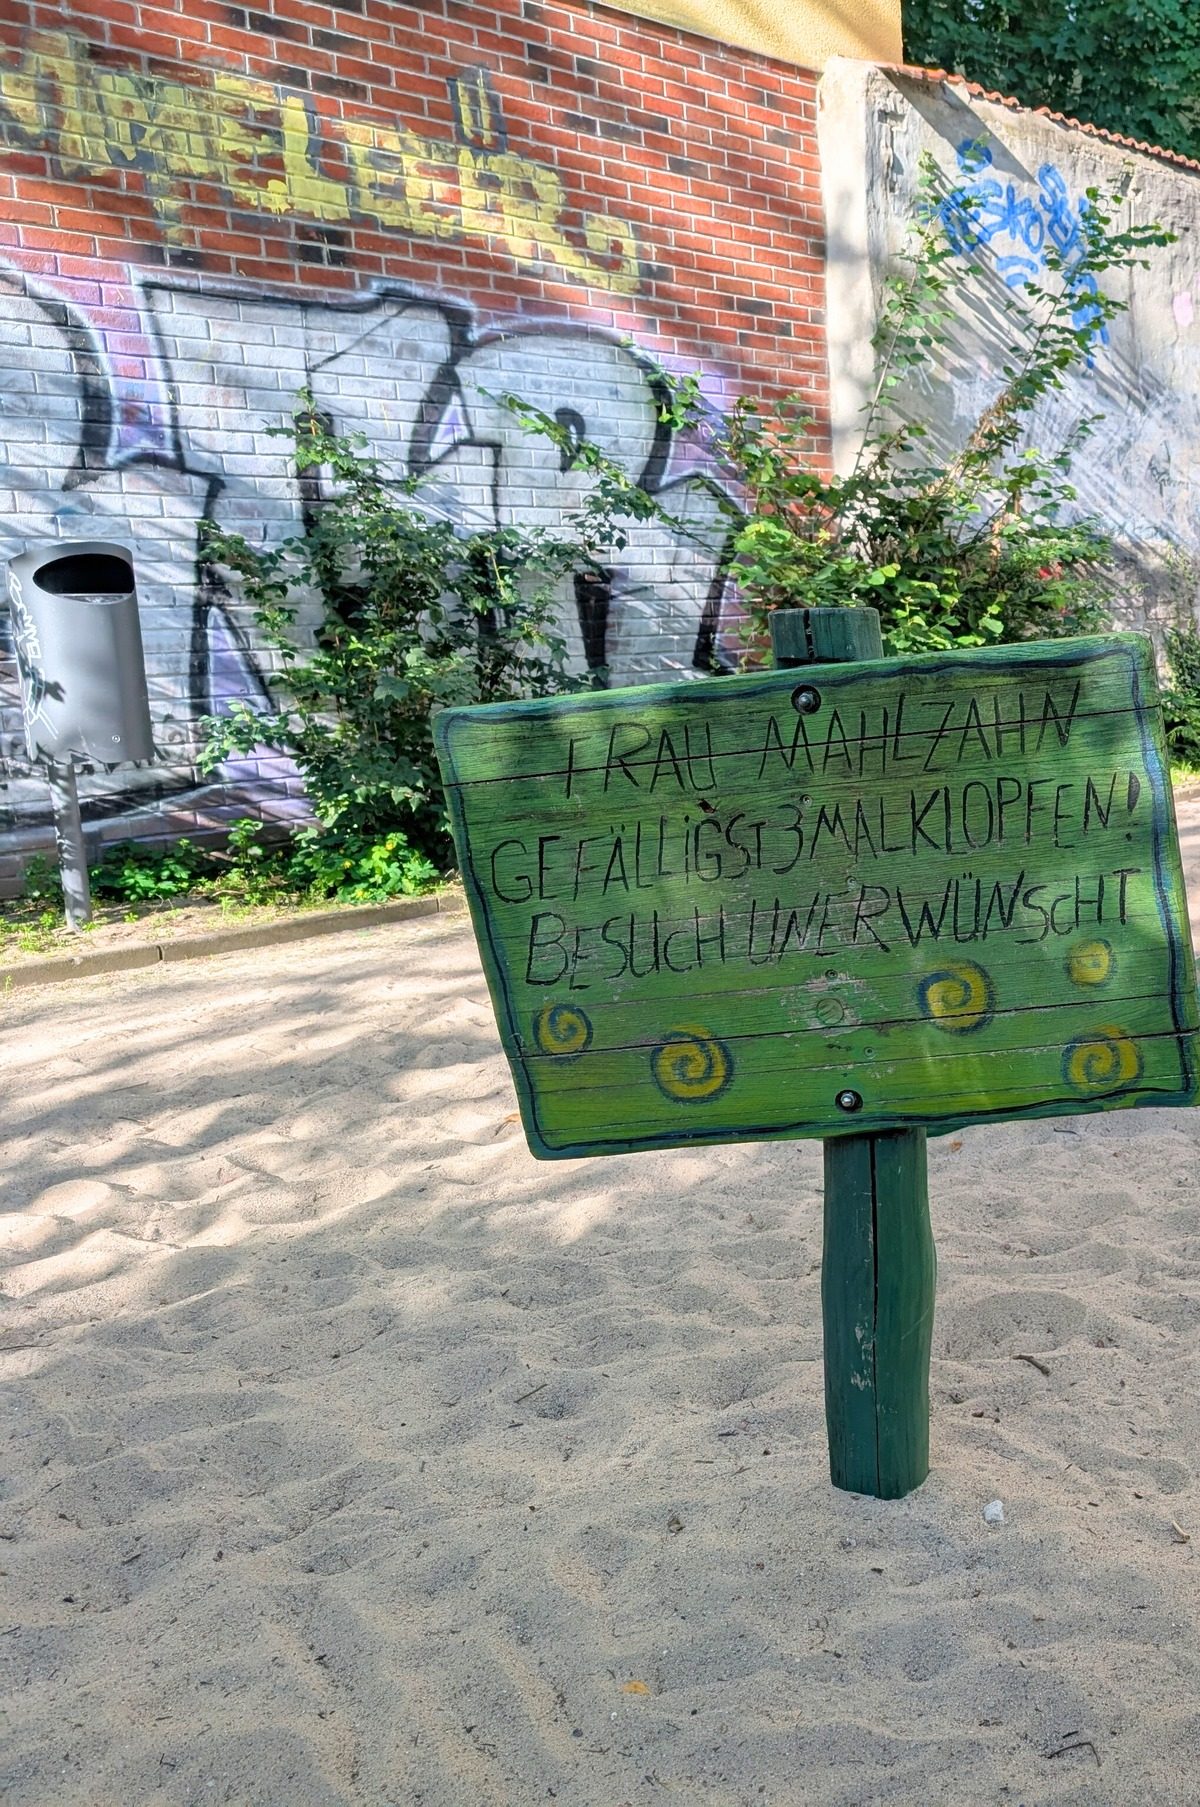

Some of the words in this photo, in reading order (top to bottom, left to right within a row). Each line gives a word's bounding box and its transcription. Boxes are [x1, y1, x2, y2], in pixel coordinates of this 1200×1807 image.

[566, 720, 718, 799] FRAU
[758, 679, 1082, 780] MAHLZAHN
[525, 904, 727, 990] BESUCH
